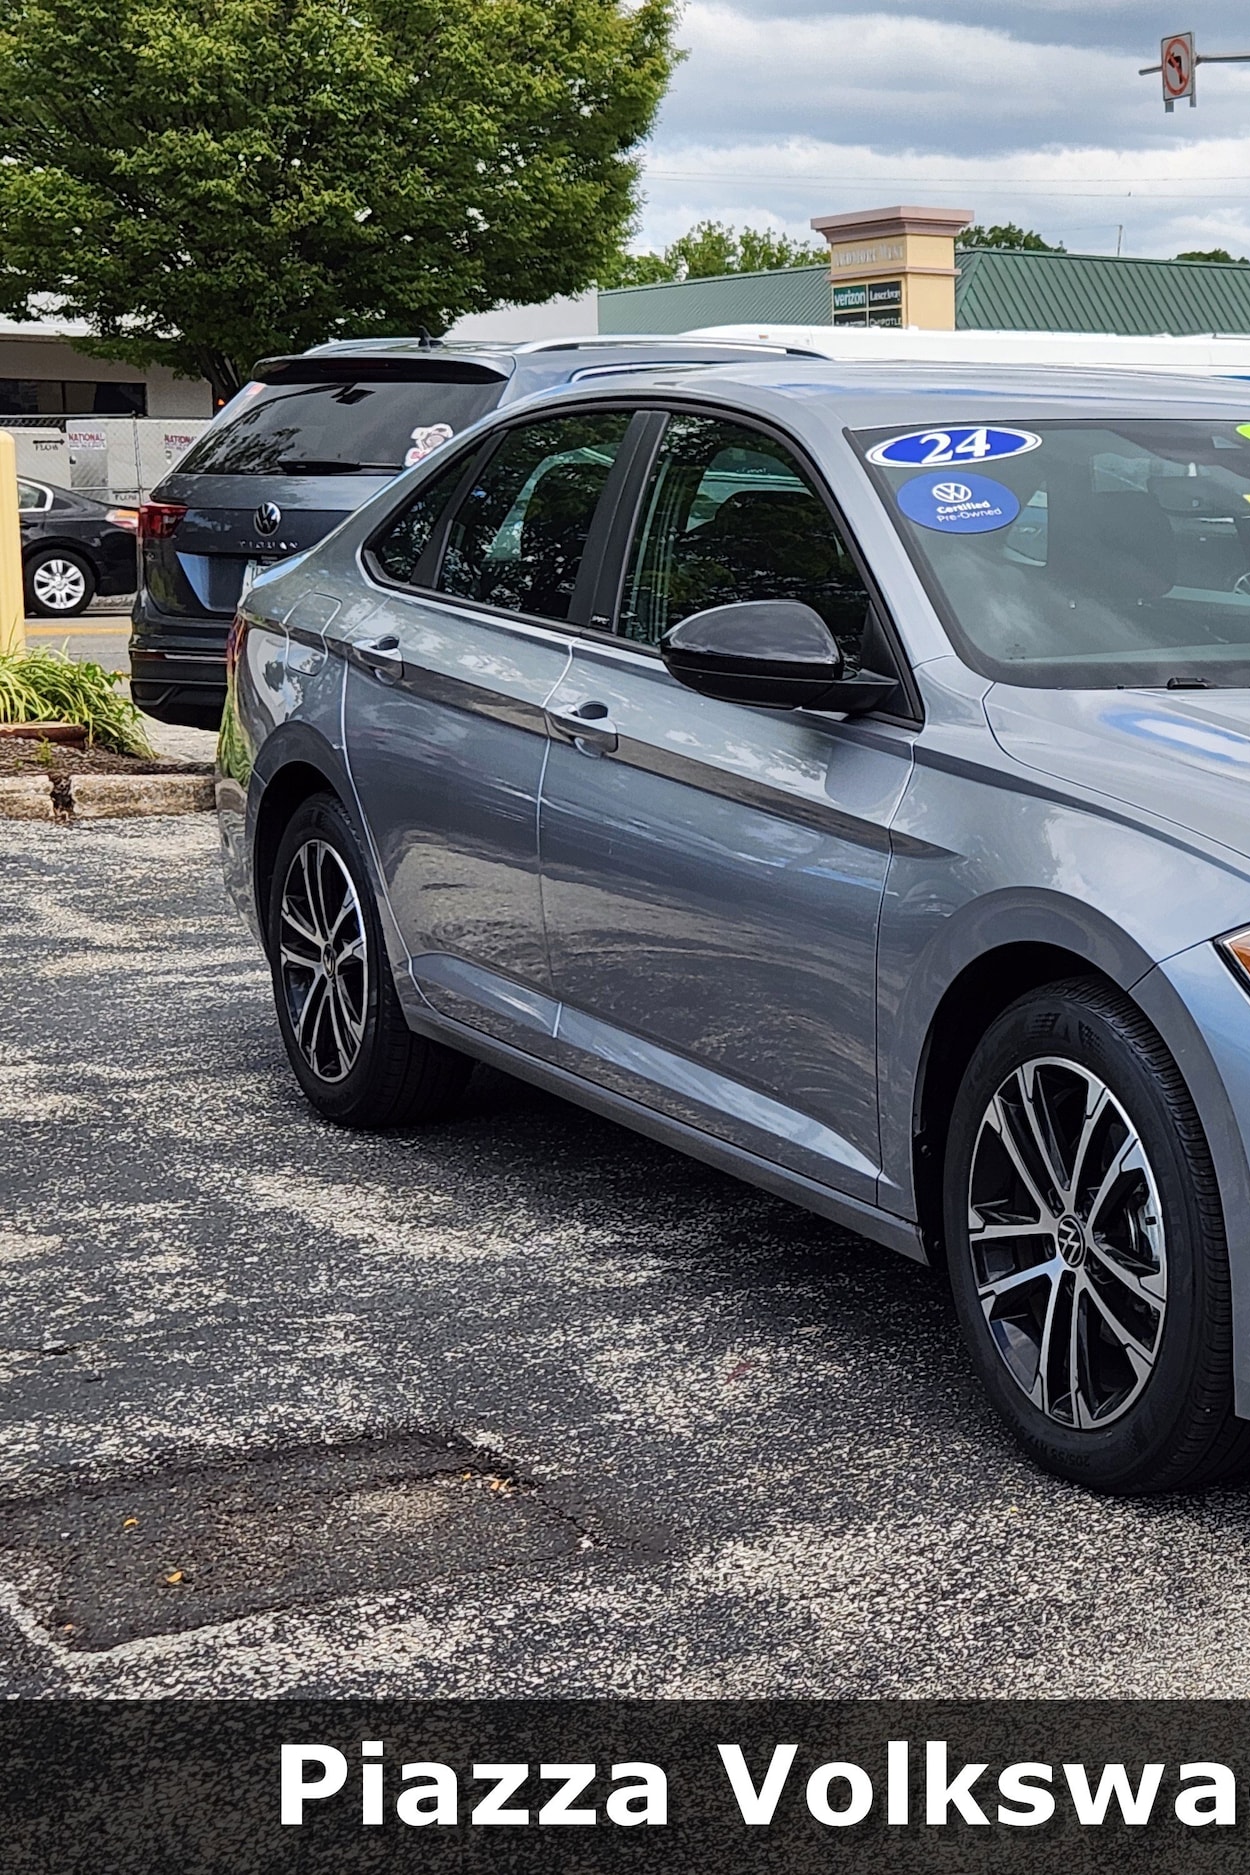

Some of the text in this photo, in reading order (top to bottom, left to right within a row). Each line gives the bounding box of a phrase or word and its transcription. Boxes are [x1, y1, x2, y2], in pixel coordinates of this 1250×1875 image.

[834, 290, 866, 307] verizon
[68, 432, 105, 441] NATIONAL
[919, 429, 991, 464] 24
[936, 500, 991, 514] Certified
[936, 507, 1002, 522] Pre-Owned
